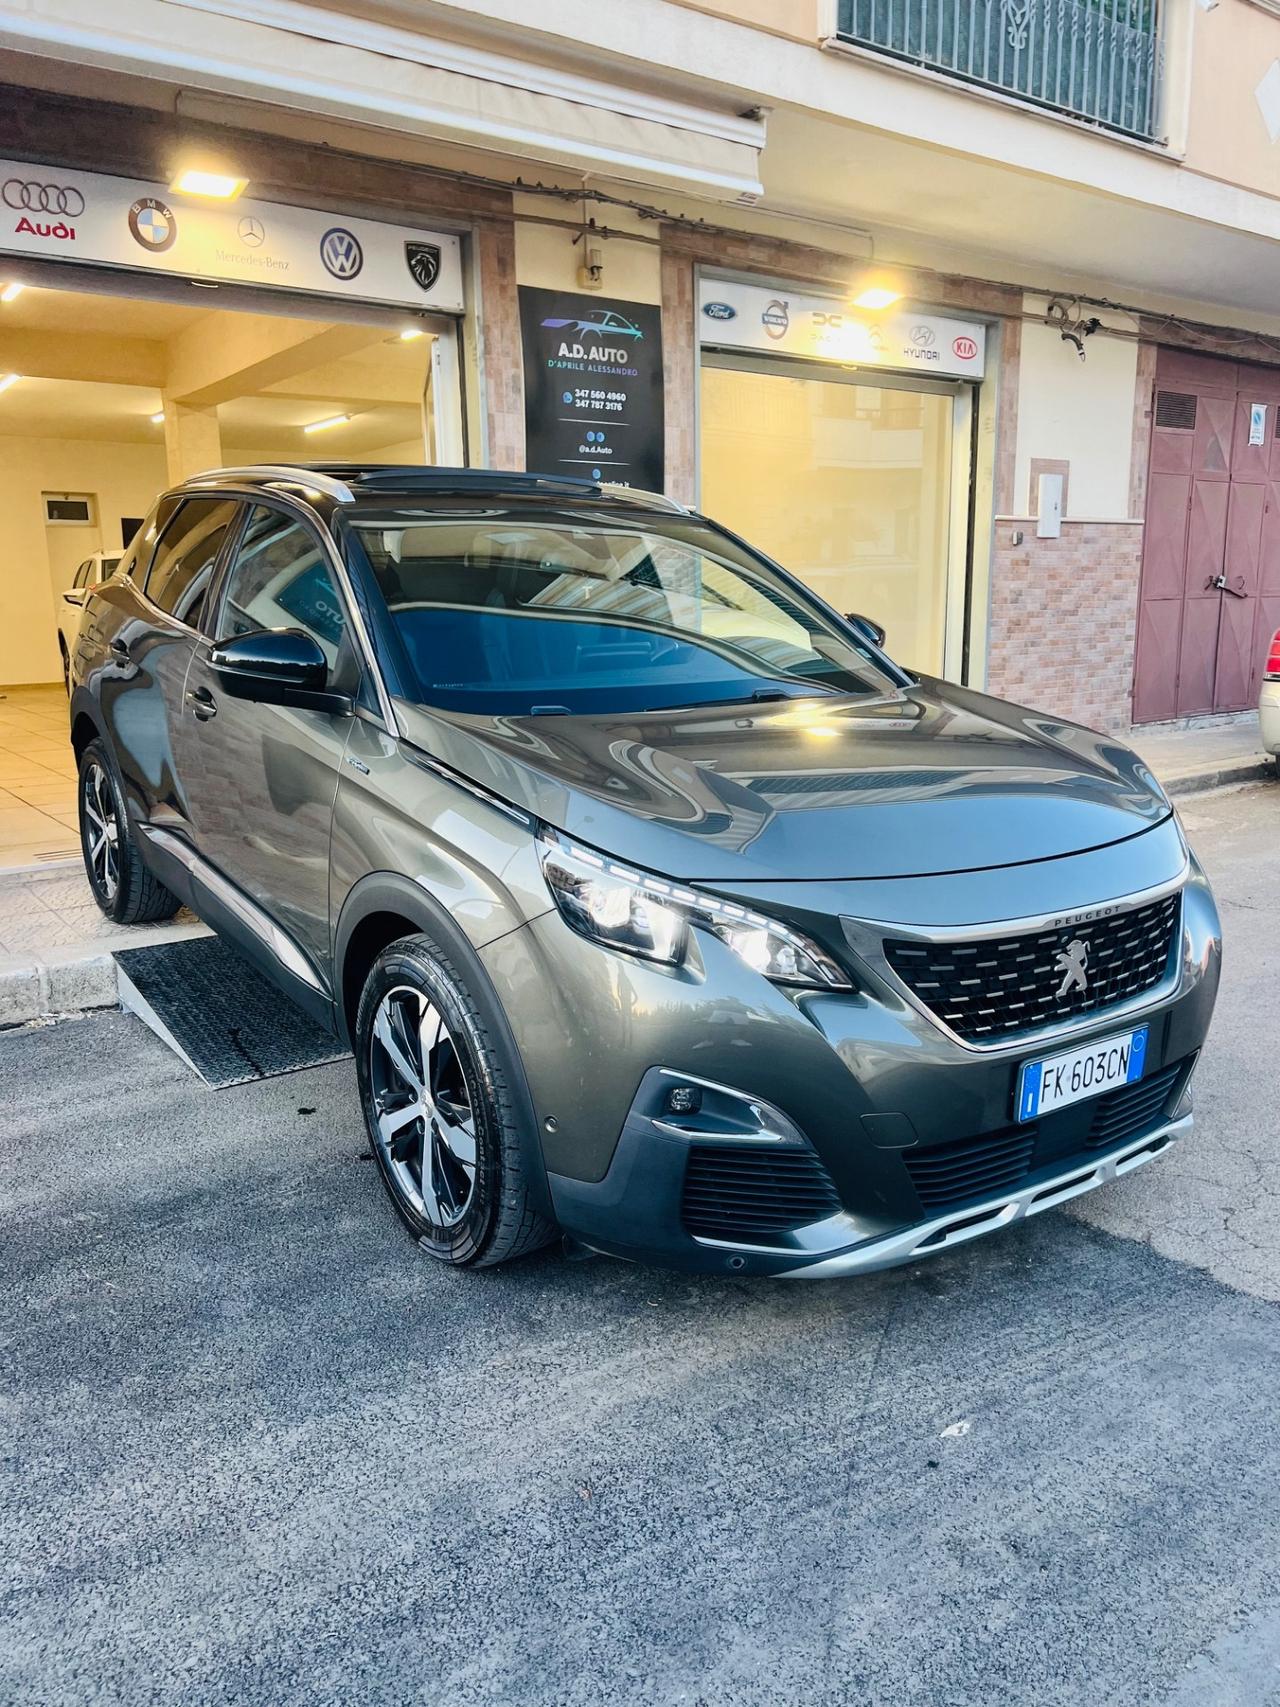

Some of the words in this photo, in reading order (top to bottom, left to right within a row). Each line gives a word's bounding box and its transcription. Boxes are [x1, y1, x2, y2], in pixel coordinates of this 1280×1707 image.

[15, 216, 75, 240] Audi
[215, 249, 289, 271] Mercedes-Benz
[708, 304, 730, 319] Ford
[903, 347, 940, 361] HYUNDAI
[956, 341, 974, 355] KIA
[548, 359, 585, 371] D'APRILE
[587, 364, 638, 377] ALESSANDRO
[575, 388, 590, 398] 347
[590, 390, 606, 400] 560
[606, 391, 627, 402] 4960
[575, 399, 590, 408] 347
[590, 400, 605, 410] 787
[1054, 905, 1121, 927] PEUGEOT
[1041, 1064, 1067, 1103] FK
[1070, 1044, 1131, 1093] 603CN
